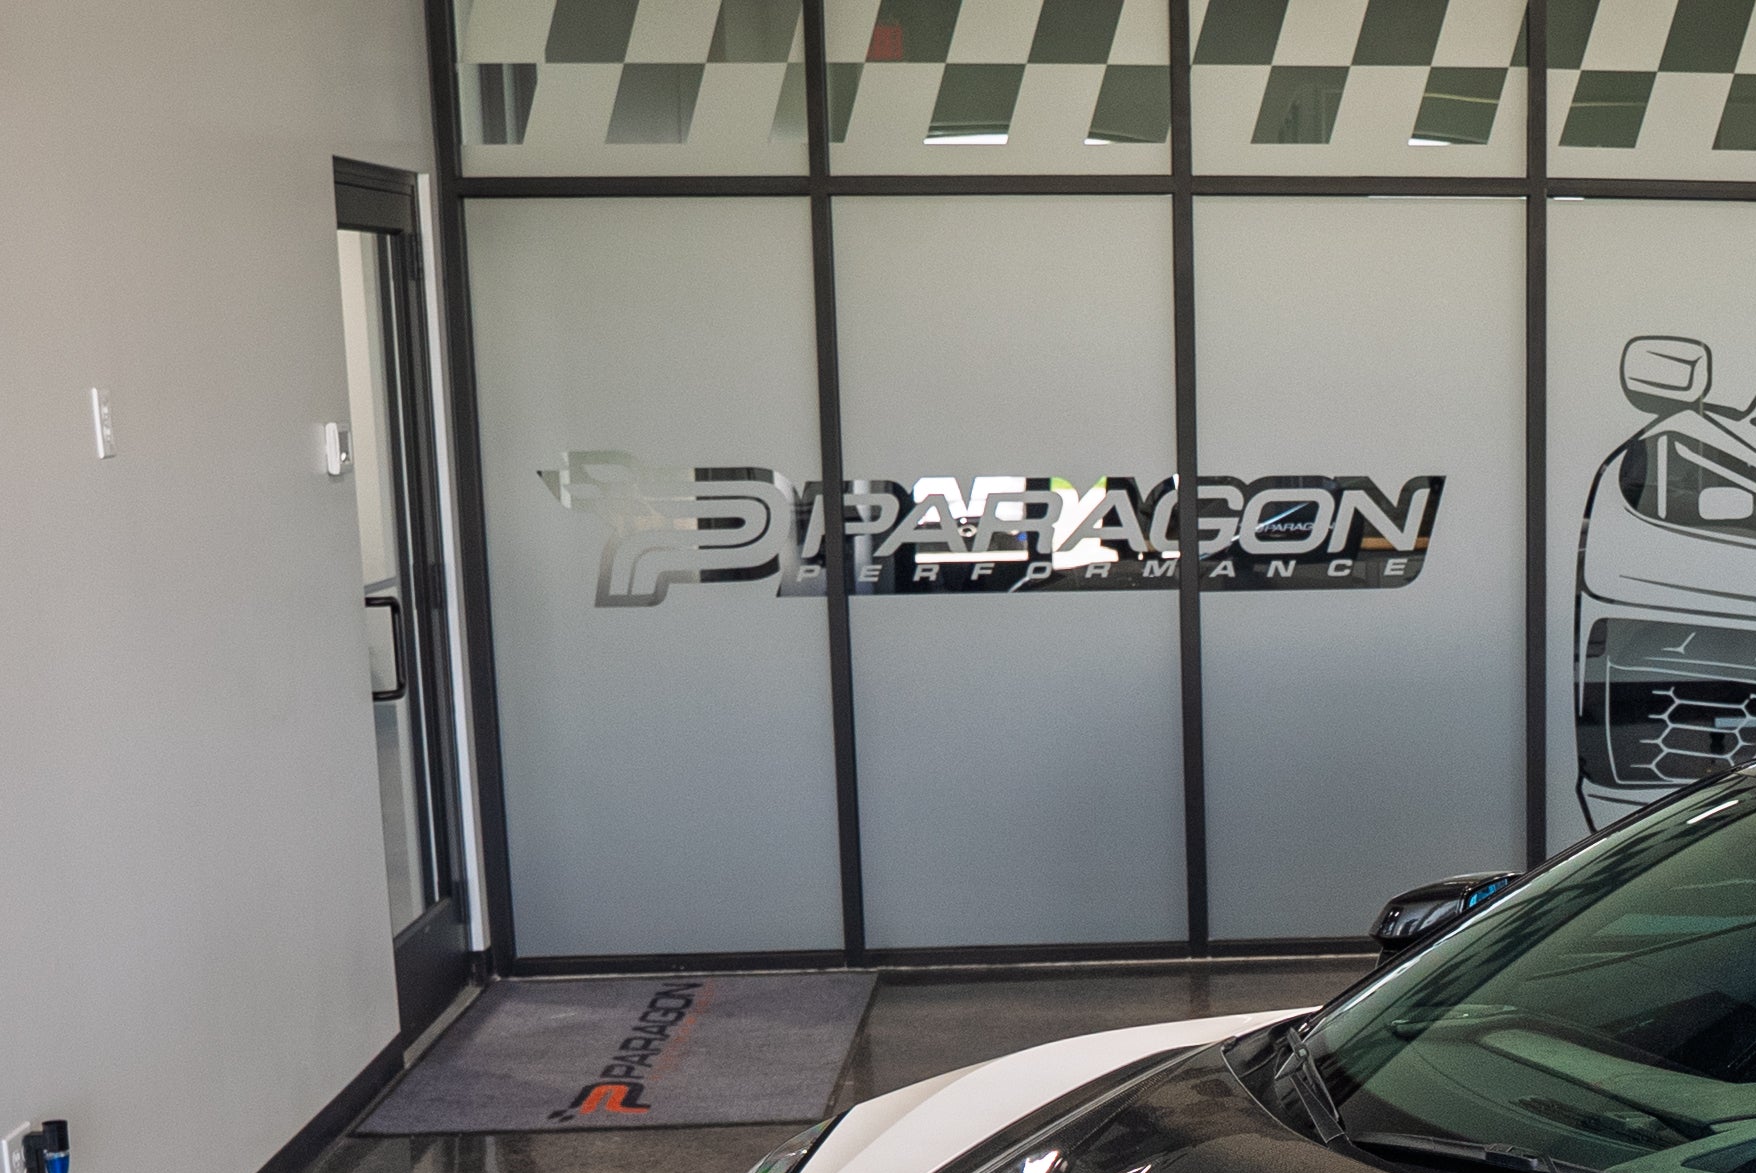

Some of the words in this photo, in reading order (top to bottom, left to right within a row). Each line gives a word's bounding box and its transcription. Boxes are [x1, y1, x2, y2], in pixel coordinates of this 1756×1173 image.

[800, 484, 1431, 558] PARAGON
[796, 557, 1409, 582] PERFORMANCE
[601, 981, 704, 1080] PARAGON
